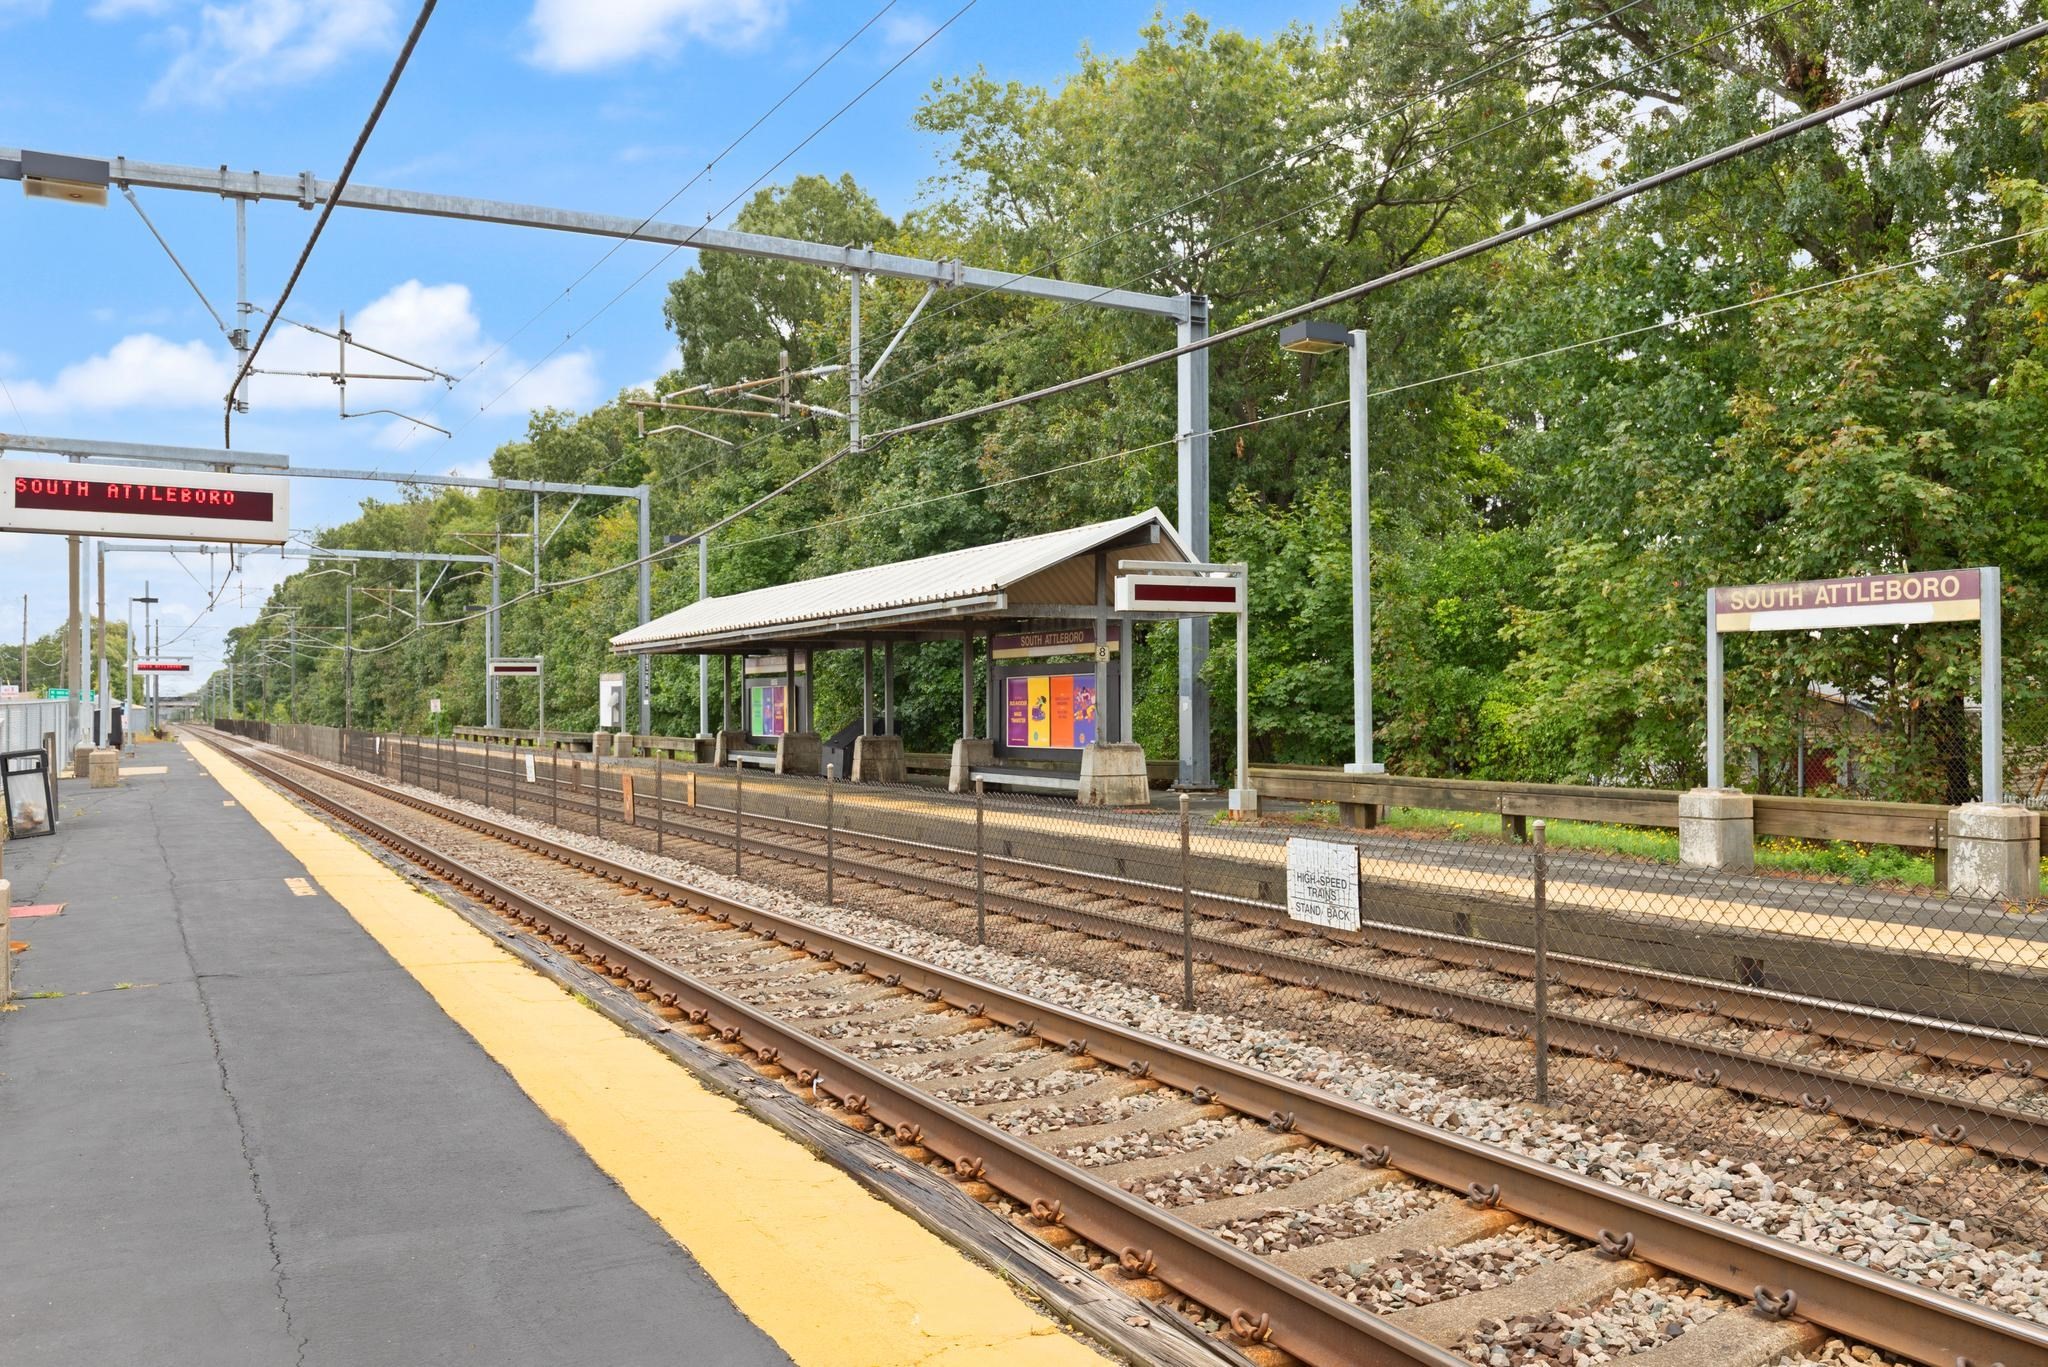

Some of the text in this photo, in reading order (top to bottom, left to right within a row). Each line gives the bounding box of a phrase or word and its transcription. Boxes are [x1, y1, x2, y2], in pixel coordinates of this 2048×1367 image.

[15, 478, 235, 505] SOUTH ATTLEBORO
[1730, 575, 1960, 611] SOUTH ATTLEBORO
[1020, 631, 1085, 647] SOUTH ATTLEBORO
[1099, 647, 1106, 657] 8
[1307, 886, 1337, 901] TRAINS
[1295, 901, 1351, 921] STAND BACK
